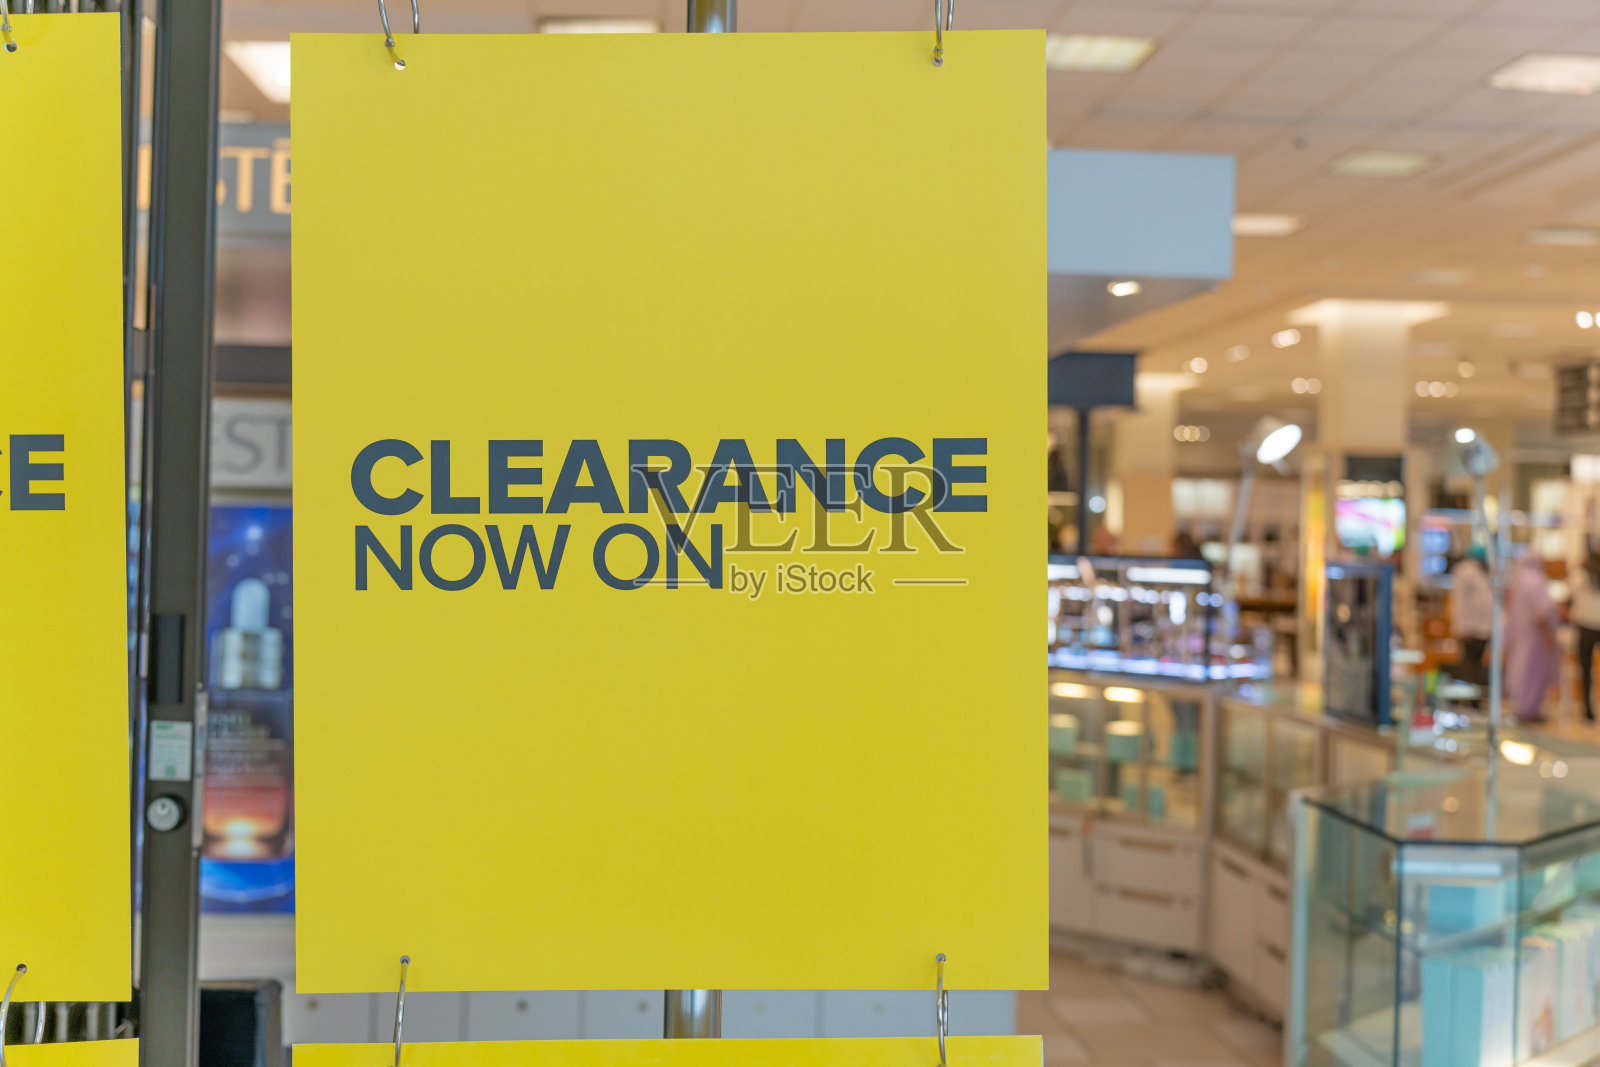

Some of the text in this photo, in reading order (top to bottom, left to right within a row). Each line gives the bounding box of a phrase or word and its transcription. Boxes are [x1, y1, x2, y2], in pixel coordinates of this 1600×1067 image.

[0, 434, 65, 511] E
[351, 437, 988, 516] CLEARANCE
[355, 524, 723, 591] NOW ON
